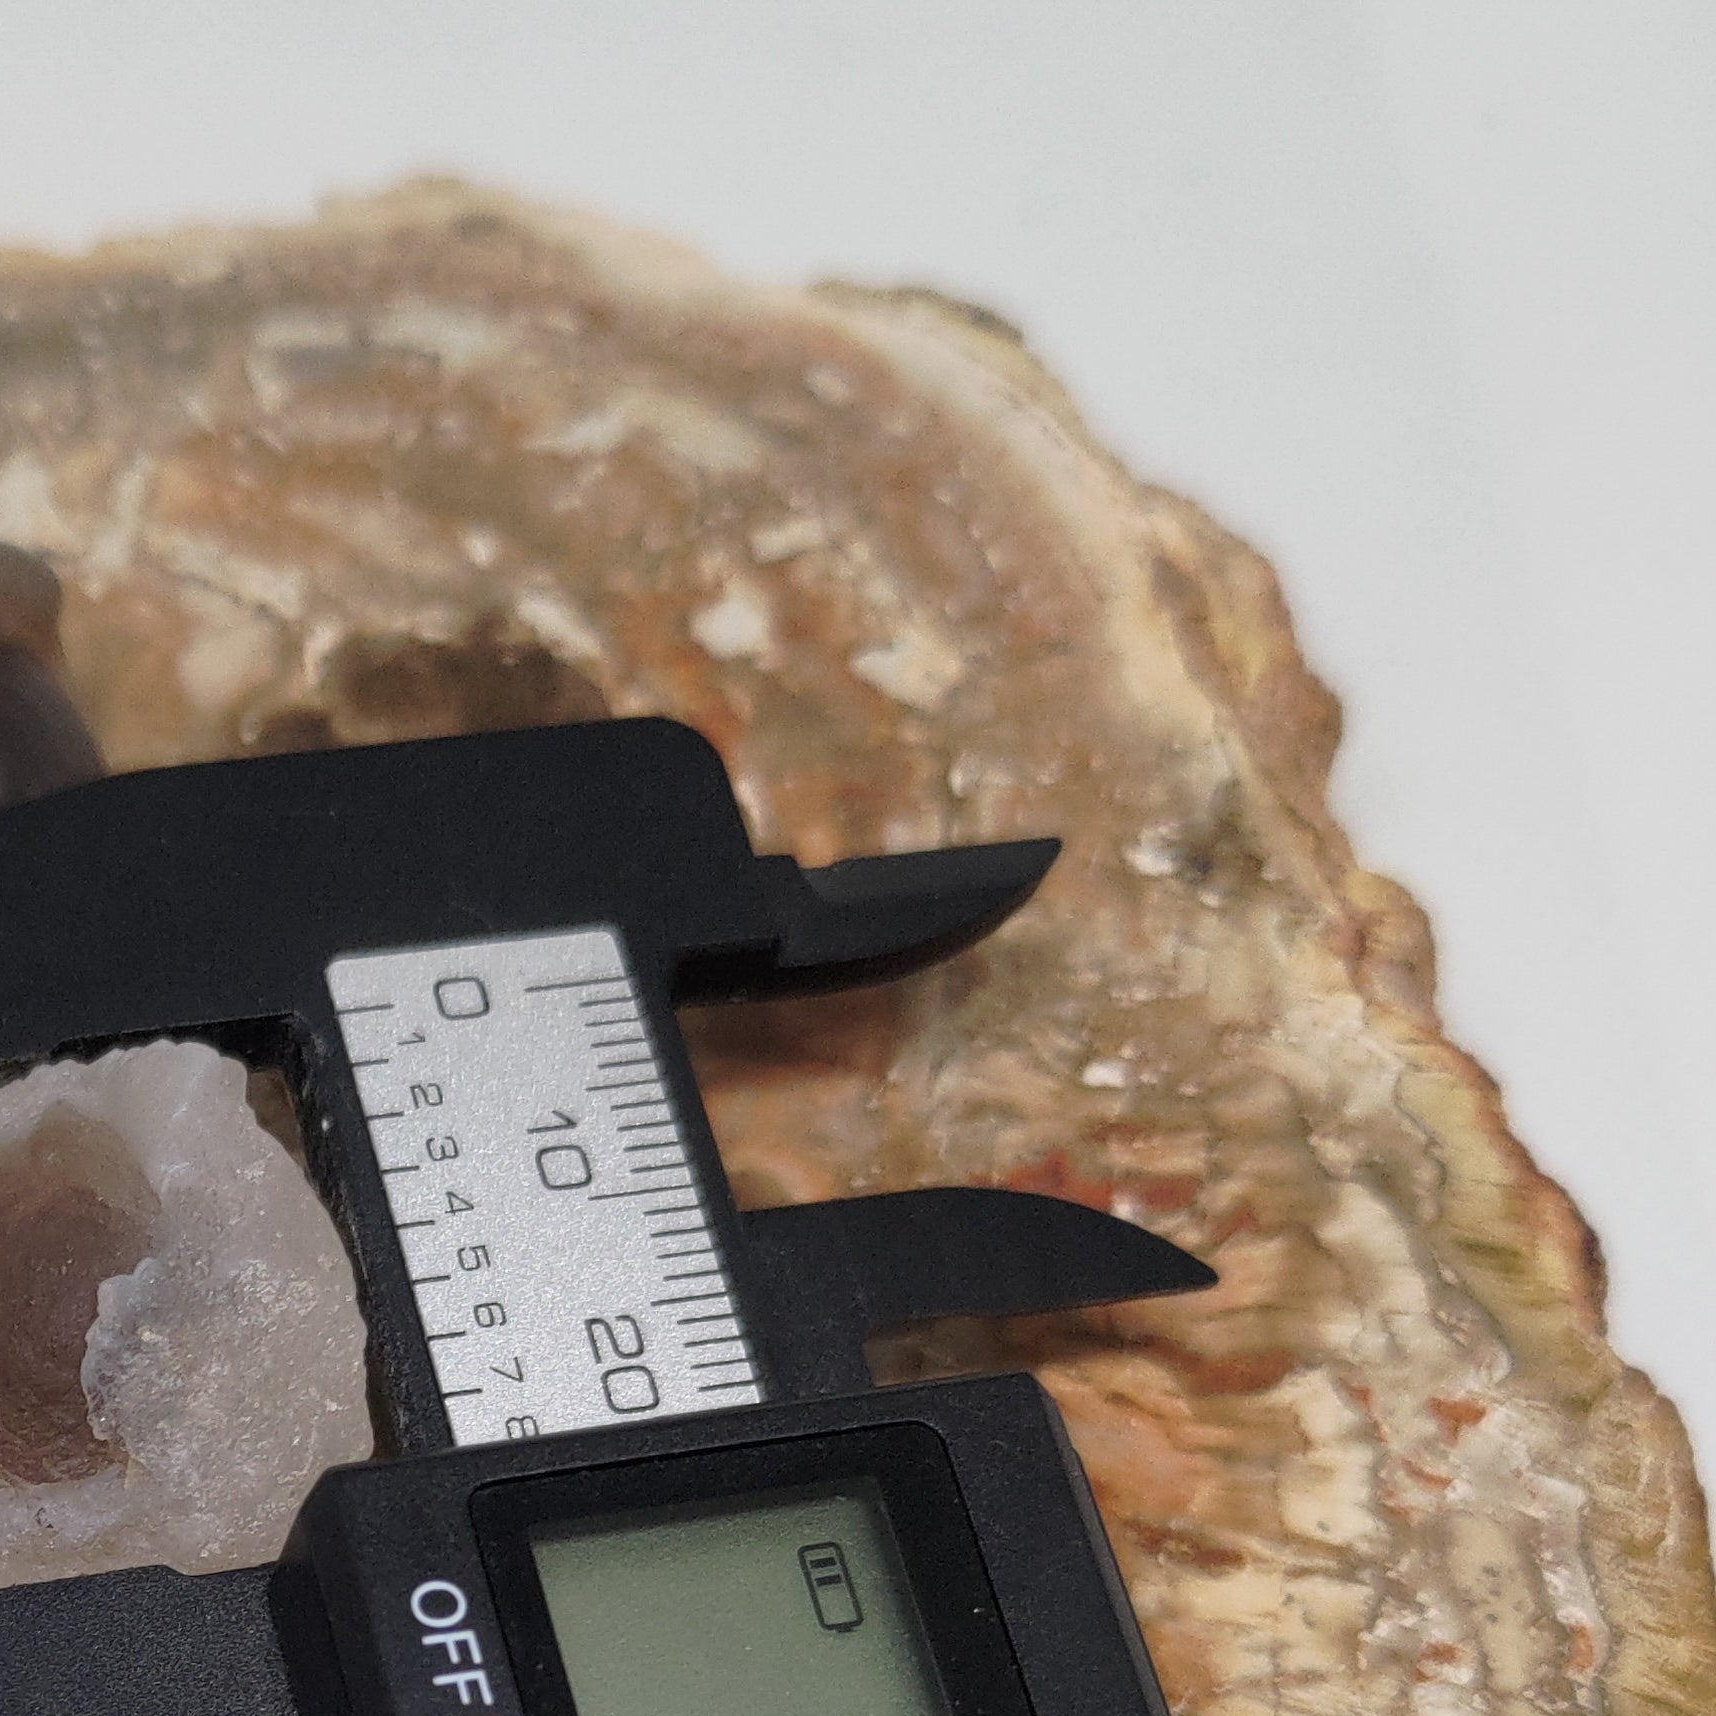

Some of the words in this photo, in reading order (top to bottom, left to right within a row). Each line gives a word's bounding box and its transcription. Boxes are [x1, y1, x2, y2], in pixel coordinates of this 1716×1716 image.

[433, 976, 490, 1020] 0
[397, 1032, 426, 1046] 1
[410, 1082, 444, 1109] 2
[425, 1136, 460, 1162] 3
[526, 1109, 593, 1191] 10
[445, 1191, 475, 1217] 4
[456, 1244, 492, 1272] 5
[473, 1302, 508, 1328] 6
[489, 1356, 525, 1383] 7
[584, 1315, 661, 1414] 20
[409, 1580, 494, 1706] OFF
